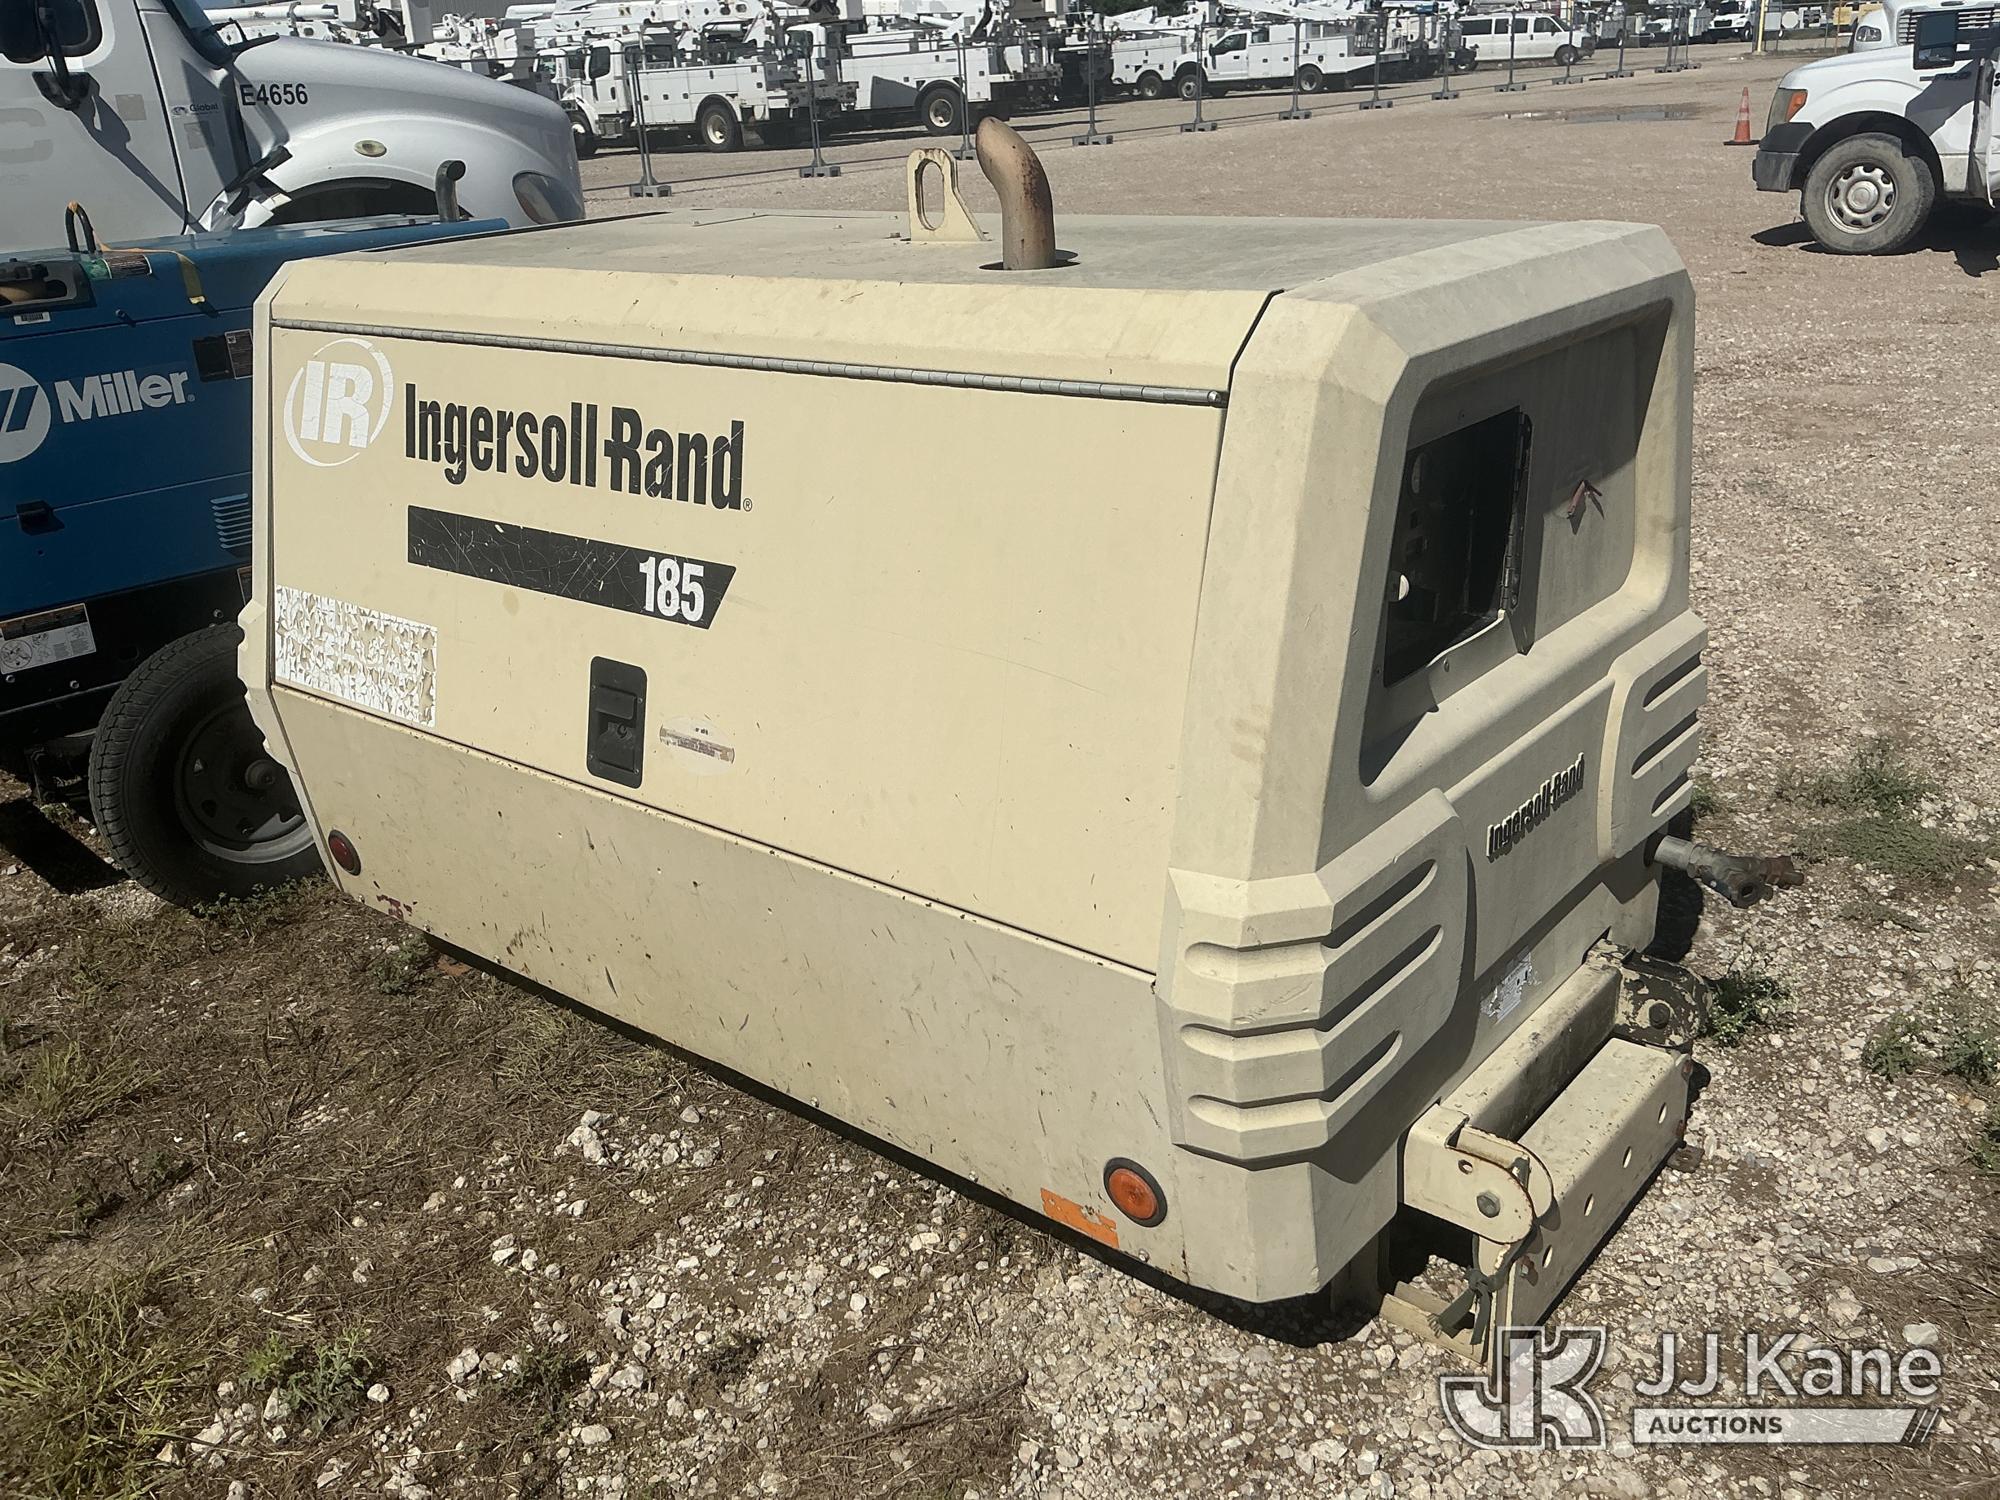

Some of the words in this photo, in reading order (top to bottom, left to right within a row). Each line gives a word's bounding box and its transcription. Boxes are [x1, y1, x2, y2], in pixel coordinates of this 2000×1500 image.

[240, 84, 308, 106] E4656
[54, 370, 189, 423] Miller
[638, 556, 704, 623] 185
